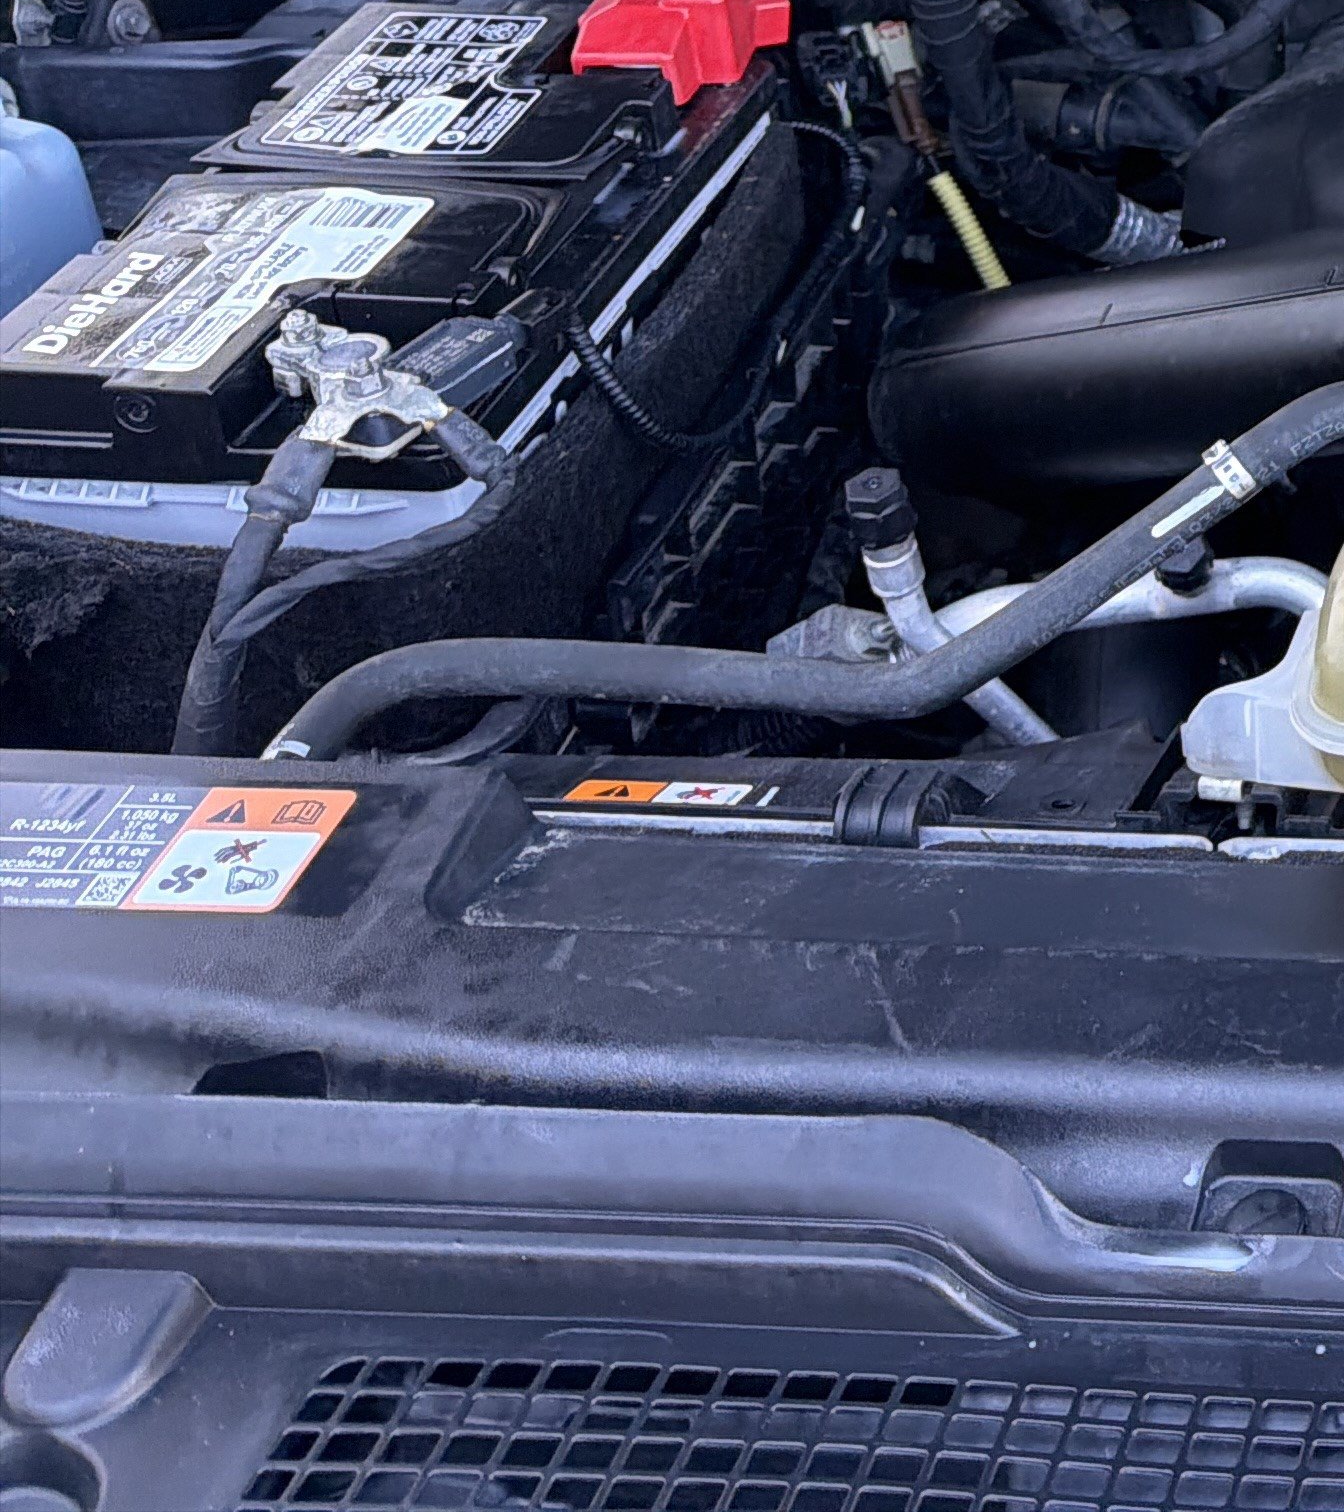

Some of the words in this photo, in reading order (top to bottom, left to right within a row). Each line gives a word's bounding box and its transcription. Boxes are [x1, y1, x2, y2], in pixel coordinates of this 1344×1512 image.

[21, 251, 164, 355] DieHard
[121, 809, 159, 821] 1.050
[159, 810, 180, 825] kg
[9, 818, 87, 835] R-1234yf
[26, 845, 67, 859] PAG
[130, 847, 151, 857] oz
[78, 857, 115, 871] (180
[116, 858, 143, 871] cc)
